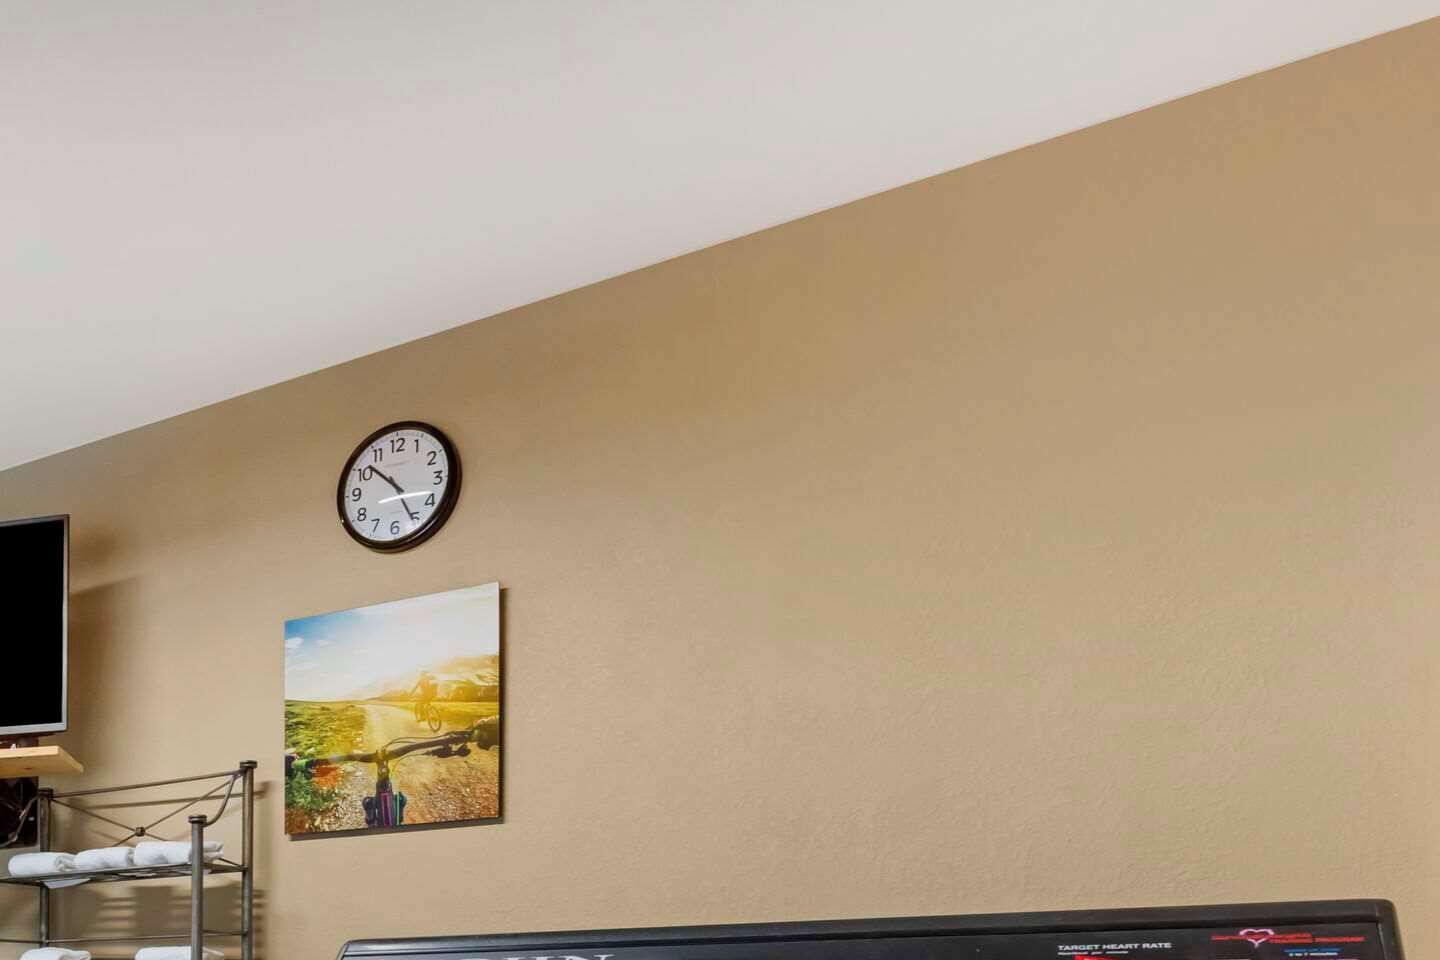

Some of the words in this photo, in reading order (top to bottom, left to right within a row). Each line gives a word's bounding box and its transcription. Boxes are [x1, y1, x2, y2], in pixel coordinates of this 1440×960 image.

[390, 438, 405, 453] 12
[414, 440, 419, 453] 1
[373, 448, 383, 462] 11
[427, 451, 436, 465] 2
[358, 468, 372, 482] 10
[433, 471, 442, 484] 3
[352, 488, 361, 502] 9
[424, 493, 435, 506] 4
[357, 508, 367, 521] 8
[372, 519, 380, 533] 7
[390, 521, 400, 534] 6
